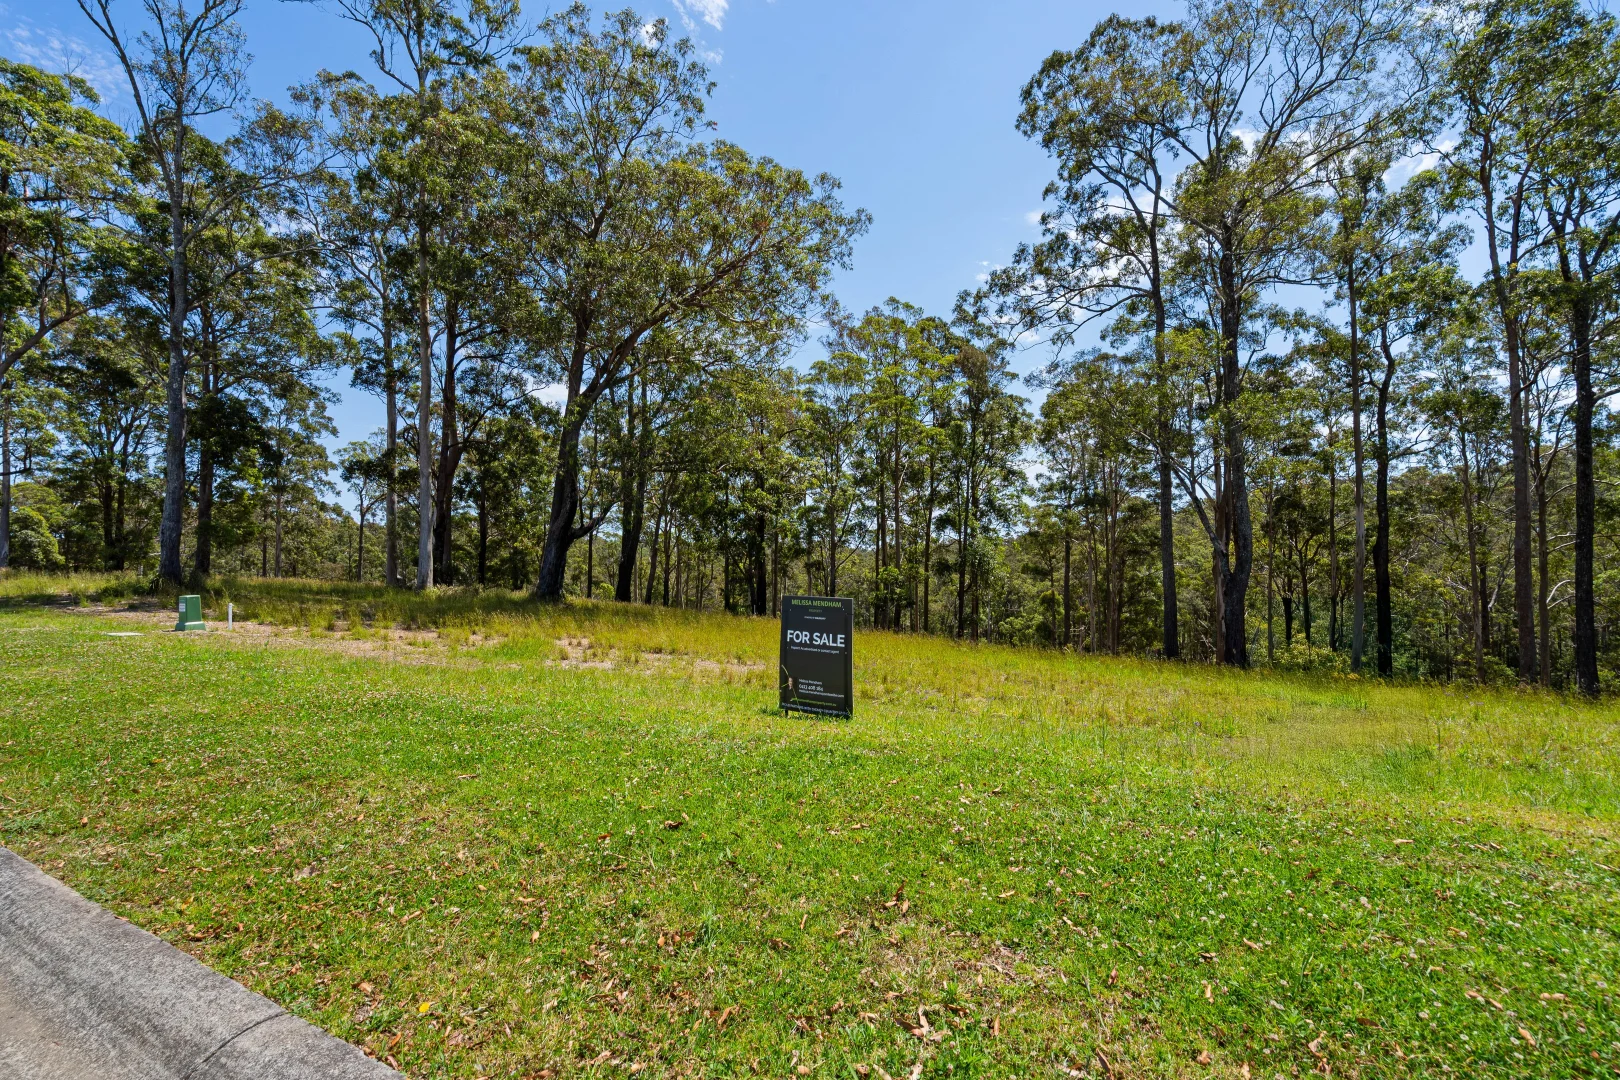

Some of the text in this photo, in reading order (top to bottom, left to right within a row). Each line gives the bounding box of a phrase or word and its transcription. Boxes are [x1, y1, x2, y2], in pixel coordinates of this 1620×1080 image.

[813, 600, 842, 608] MENDHAM
[787, 630, 845, 647] FOR SALE
